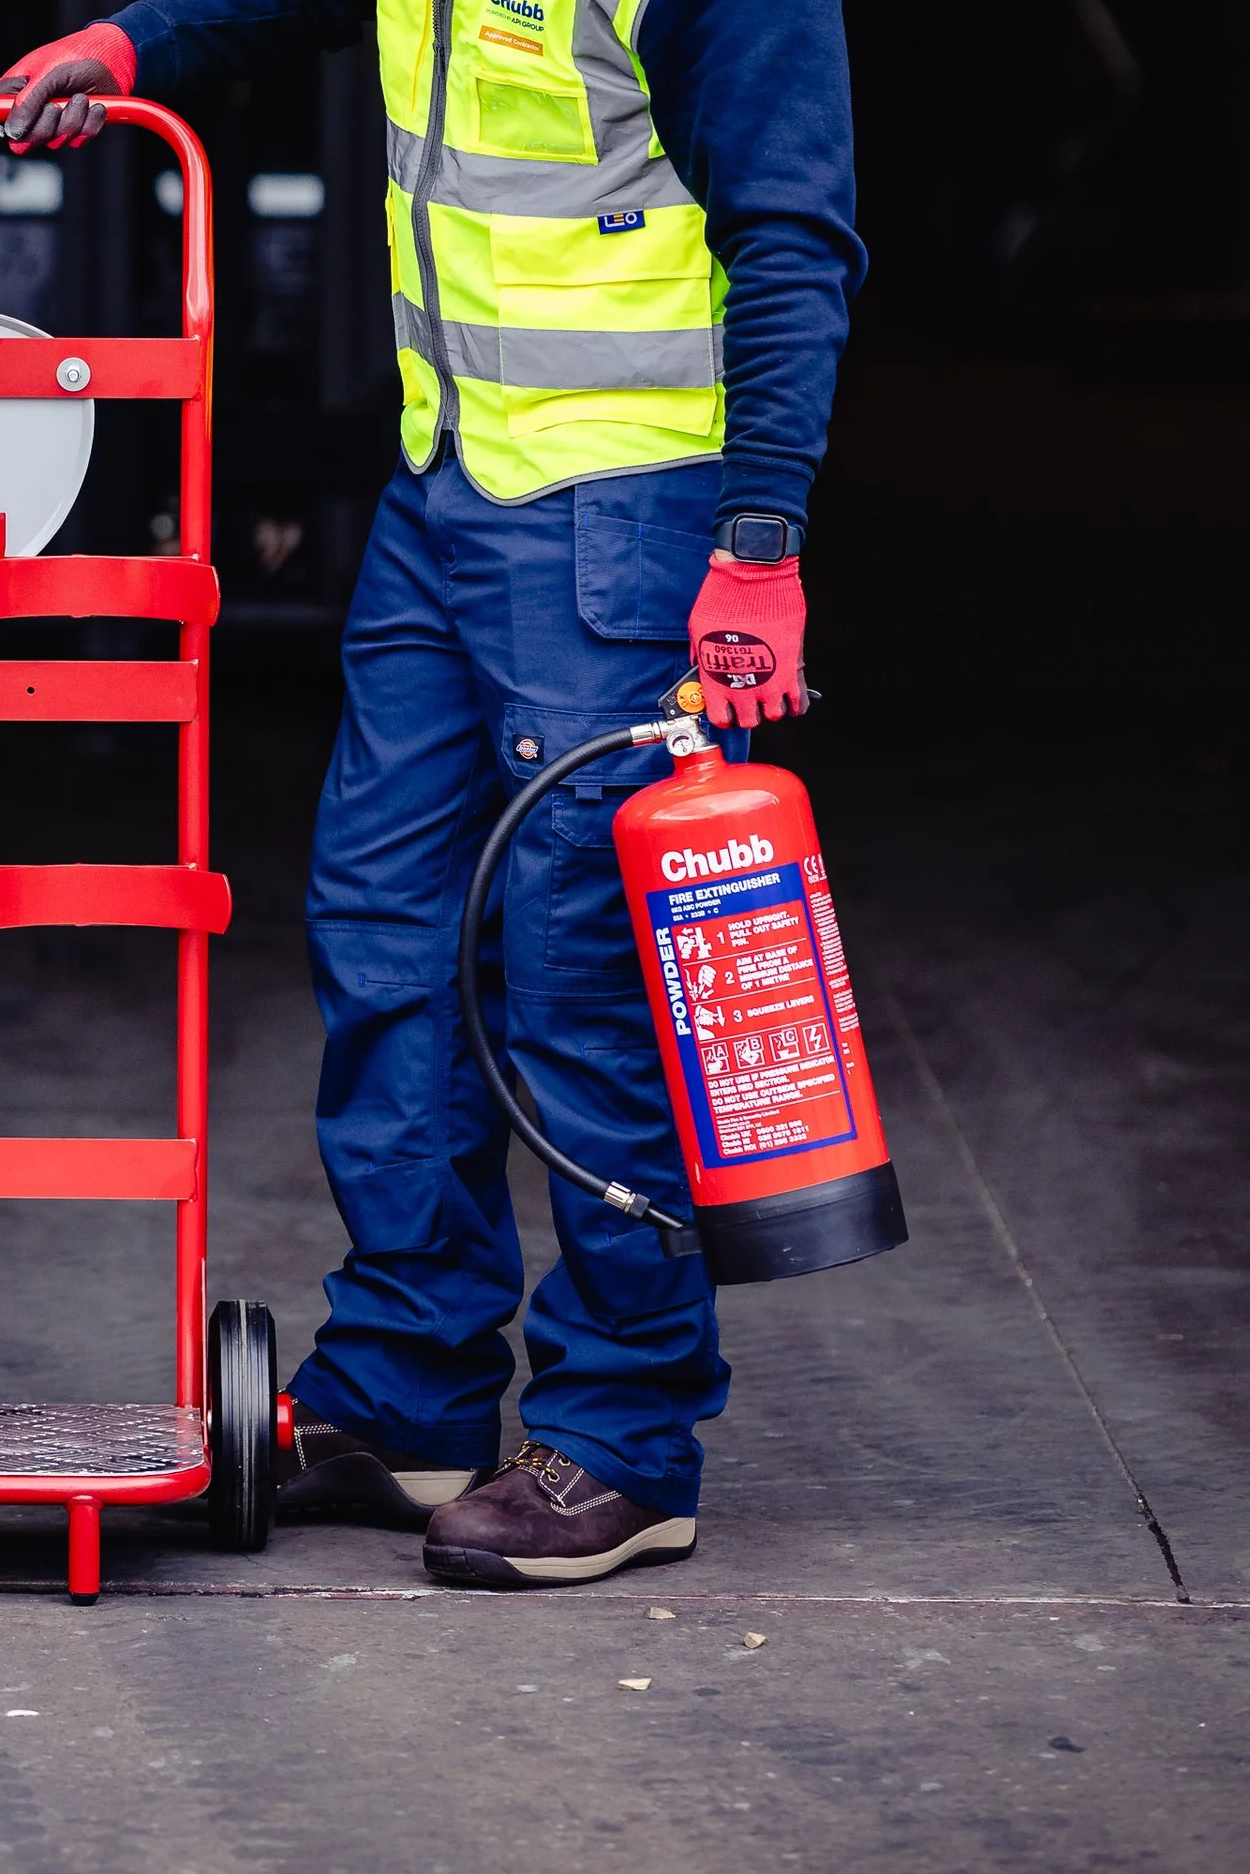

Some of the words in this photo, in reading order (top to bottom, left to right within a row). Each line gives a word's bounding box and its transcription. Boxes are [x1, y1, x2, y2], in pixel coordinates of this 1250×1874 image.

[522, 21, 544, 32] GROUP
[485, 31, 513, 43] Approved
[513, 38, 540, 51] Contractor
[604, 212, 637, 227] LEO
[715, 645, 753, 655] TG1360
[706, 653, 771, 670] Traffi
[661, 834, 774, 882] Chubb
[669, 891, 694, 905] FIRE
[695, 873, 781, 900] EXTINGUISHER
[695, 899, 721, 909] POWDER
[728, 920, 752, 931] HOLD
[753, 911, 790, 925] UPRIGHT.
[730, 929, 752, 939] PULL
[753, 924, 770, 934] OUT
[771, 916, 799, 930] SAFETY
[717, 931, 725, 944] 1
[731, 937, 749, 947] PIN.
[737, 957, 752, 966] AIM
[754, 954, 764, 962] AT
[765, 948, 787, 960] BASE
[787, 946, 798, 955] OF
[737, 964, 757, 975] FIRE
[757, 958, 782, 970] FROM
[739, 968, 778, 983] MINIMUM
[778, 958, 814, 973] DISTANCE
[656, 927, 691, 1036] POWDER
[724, 971, 735, 984] 2
[741, 981, 753, 991] OF
[754, 980, 760, 988] 1
[733, 1009, 743, 1023] 3
[747, 1002, 785, 1017] SQUEEZE
[785, 995, 814, 1009] LEVERS
[716, 1044, 725, 1057] A
[751, 1038, 761, 1050] B
[785, 1031, 795, 1042] C
[708, 1080, 718, 1089] DO
[719, 1078, 734, 1087] NOT
[735, 1075, 750, 1084] USE
[751, 1072, 759, 1081] IF
[759, 1064, 800, 1079] PRESSURE
[800, 1055, 835, 1071] INDICATOR
[710, 1087, 737, 1097] ENTERS
[737, 1083, 753, 1092] RED
[754, 1075, 790, 1089] SECTION.
[712, 1097, 723, 1106] DO
[724, 1095, 741, 1104] NOT
[742, 1091, 759, 1101] USE
[760, 1083, 796, 1097] OUTSIDE
[797, 1073, 835, 1089] SPECIFIED
[713, 1097, 771, 1114] TEMPERATURE
[771, 1091, 803, 1103] RANGE.
[723, 1147, 743, 1155] Chubb
